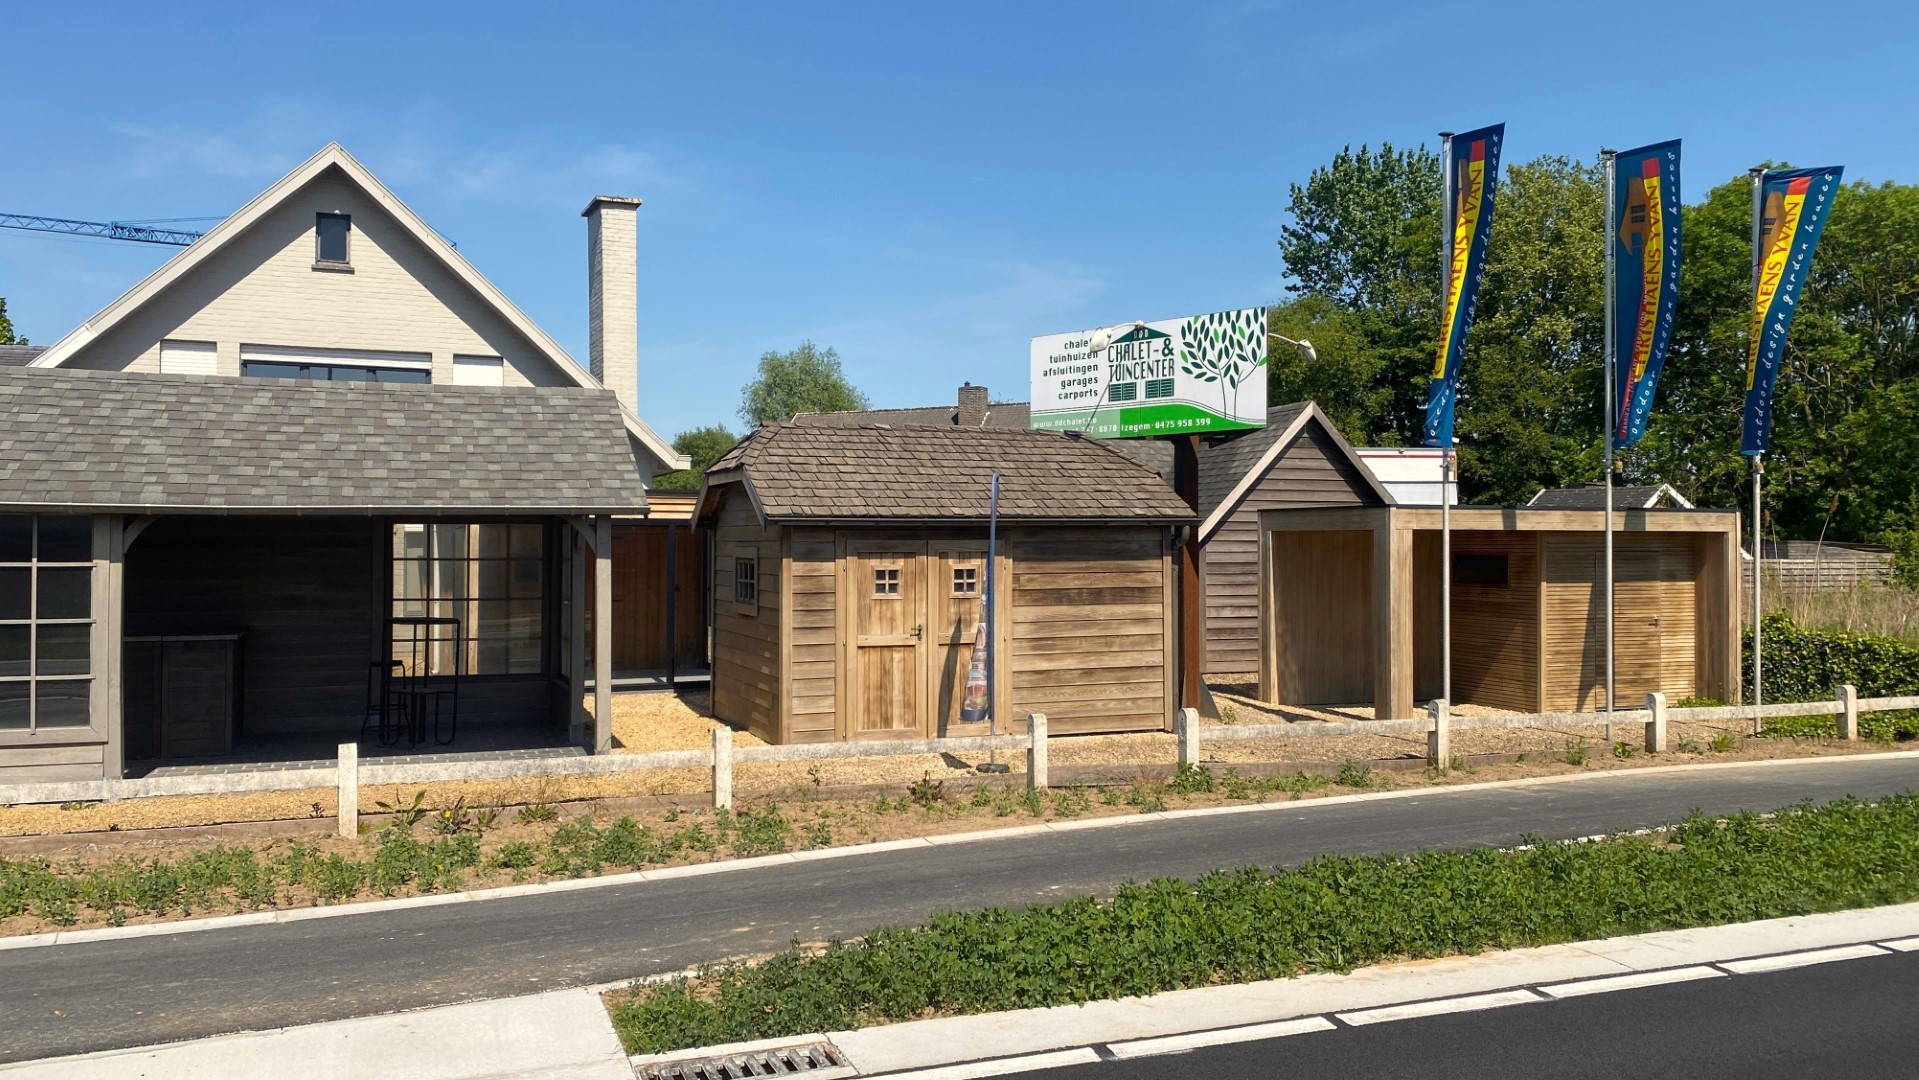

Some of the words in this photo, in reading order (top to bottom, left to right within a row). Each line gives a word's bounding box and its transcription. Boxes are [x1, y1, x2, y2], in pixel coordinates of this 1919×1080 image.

[1459, 168, 1483, 229] YVAN
[1647, 185, 1661, 242] YVAN
[1805, 173, 1833, 233] houses
[1772, 202, 1800, 255] YVAN
[1783, 243, 1808, 306] garden
[1050, 352, 1098, 364] tuinhuizen
[1631, 370, 1656, 434] outdoor
[1655, 301, 1674, 359] design
[1669, 227, 1679, 292] garden
[1762, 312, 1786, 369] design
[1043, 364, 1099, 377] afsluitingen
[1058, 388, 1098, 400] carports
[1061, 376, 1099, 390] garages
[1108, 358, 1175, 382] TUINCENTER
[1177, 418, 1193, 427] 958
[1757, 380, 1768, 446] outdoor
